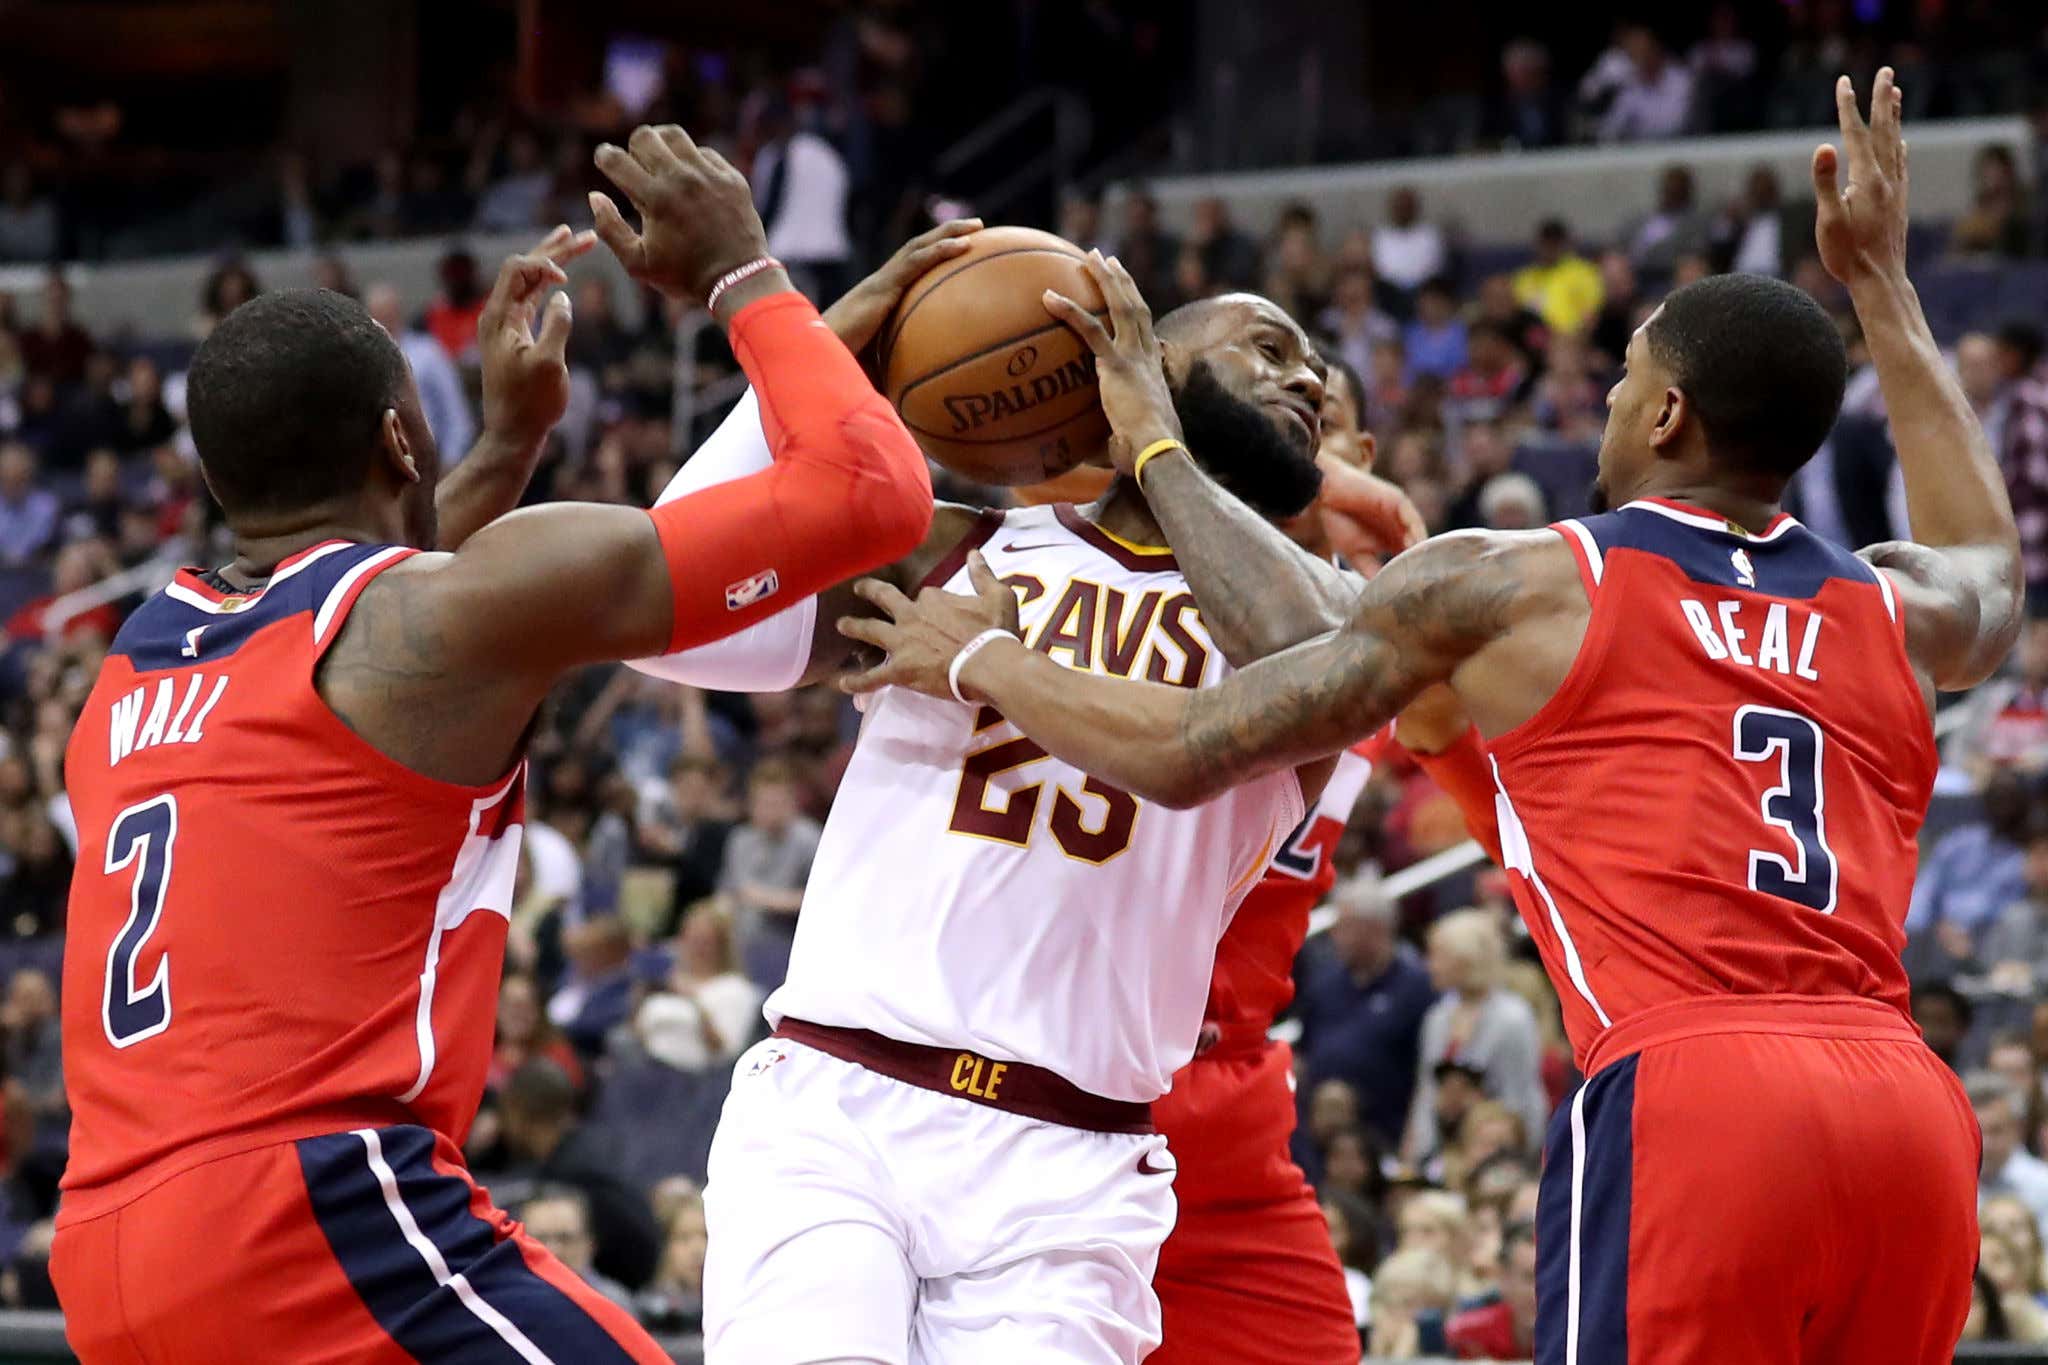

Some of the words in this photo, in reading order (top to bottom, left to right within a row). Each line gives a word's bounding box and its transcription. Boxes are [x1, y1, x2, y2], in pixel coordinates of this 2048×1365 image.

[944, 352, 1097, 432] SPALDIN
[1679, 600, 1822, 681] BEAL
[110, 673, 229, 767] WALL
[1733, 704, 1838, 915] 3
[102, 793, 177, 1049] 2
[949, 1053, 1008, 1100] CLE
